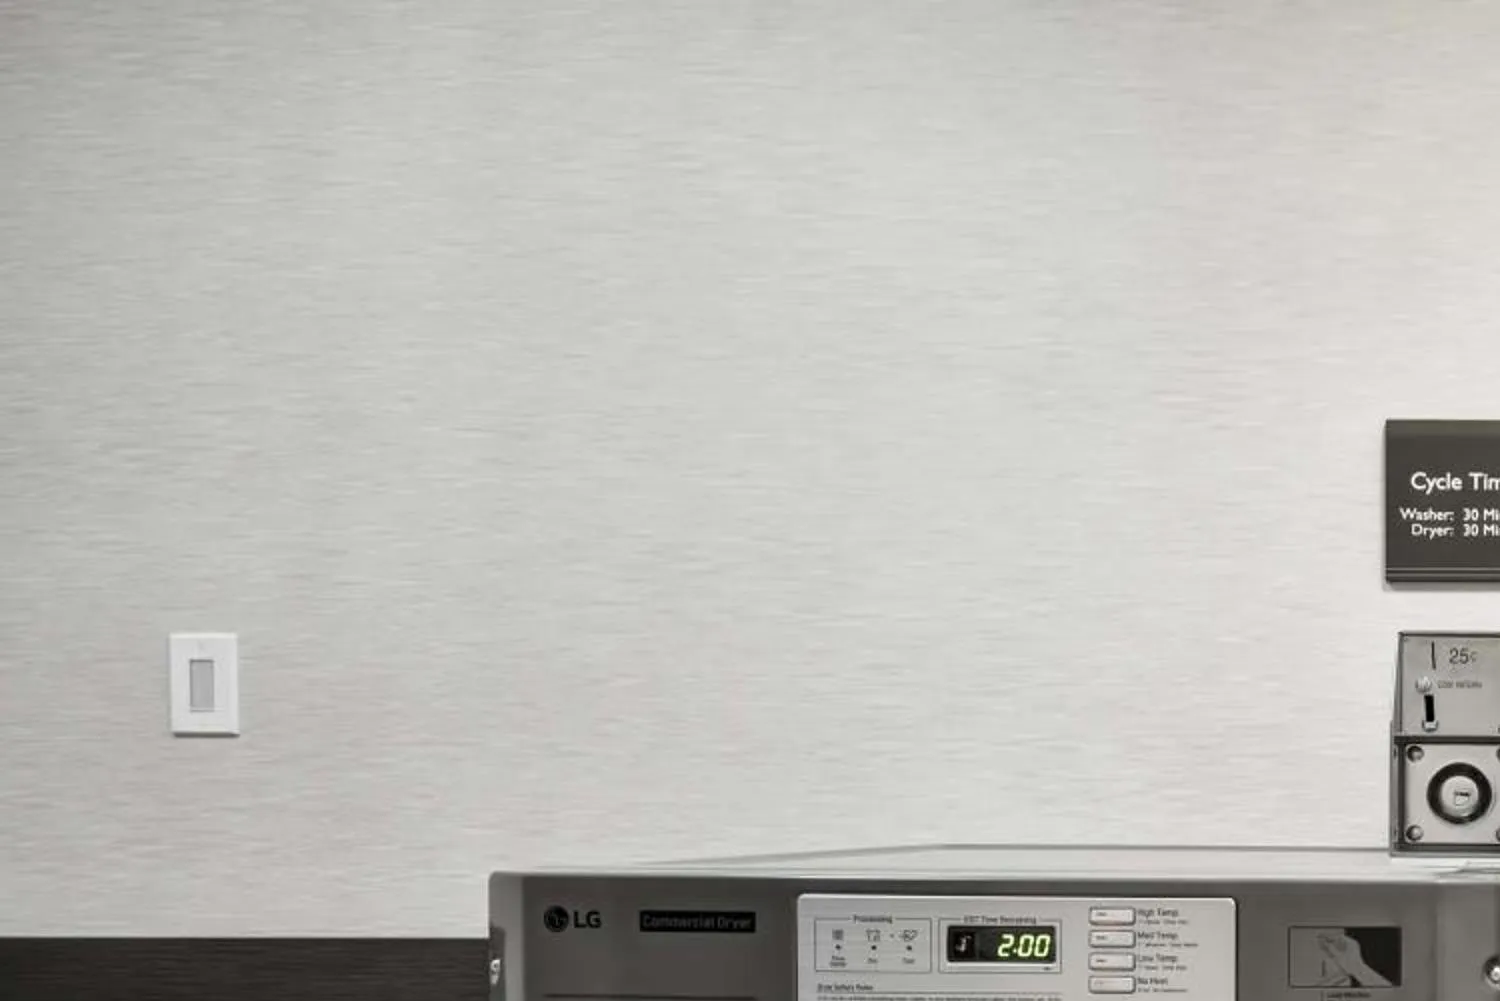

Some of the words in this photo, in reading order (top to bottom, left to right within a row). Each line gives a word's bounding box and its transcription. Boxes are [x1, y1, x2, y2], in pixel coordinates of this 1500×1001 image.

[1410, 471, 1463, 495] Cycle
[1399, 507, 1455, 522] Washer:
[1462, 508, 1479, 522] 30
[1411, 523, 1455, 540] Dryer:
[1462, 523, 1479, 537] 30
[573, 911, 602, 929] LG
[642, 914, 715, 928] Commercial
[717, 915, 752, 930] Dryer
